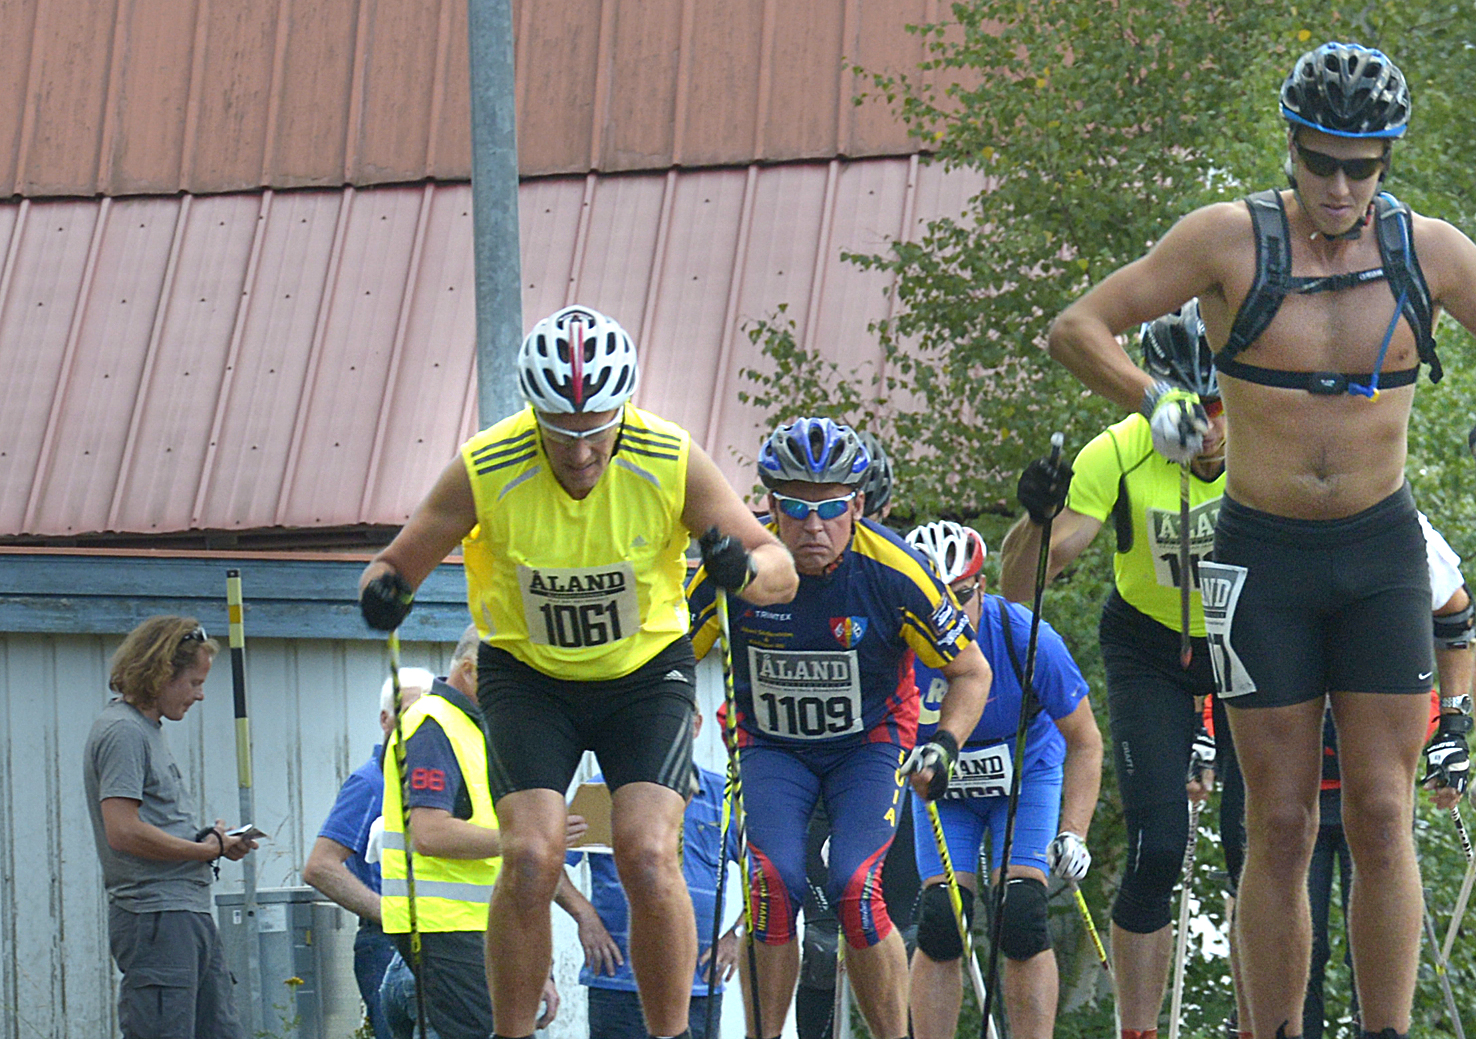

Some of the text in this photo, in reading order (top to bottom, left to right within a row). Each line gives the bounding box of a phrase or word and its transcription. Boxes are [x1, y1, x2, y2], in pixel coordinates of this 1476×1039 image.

[530, 569, 626, 593] ÅLAND
[539, 600, 622, 648] 1061
[760, 654, 849, 681] ÅLAND
[760, 692, 854, 737] 1109
